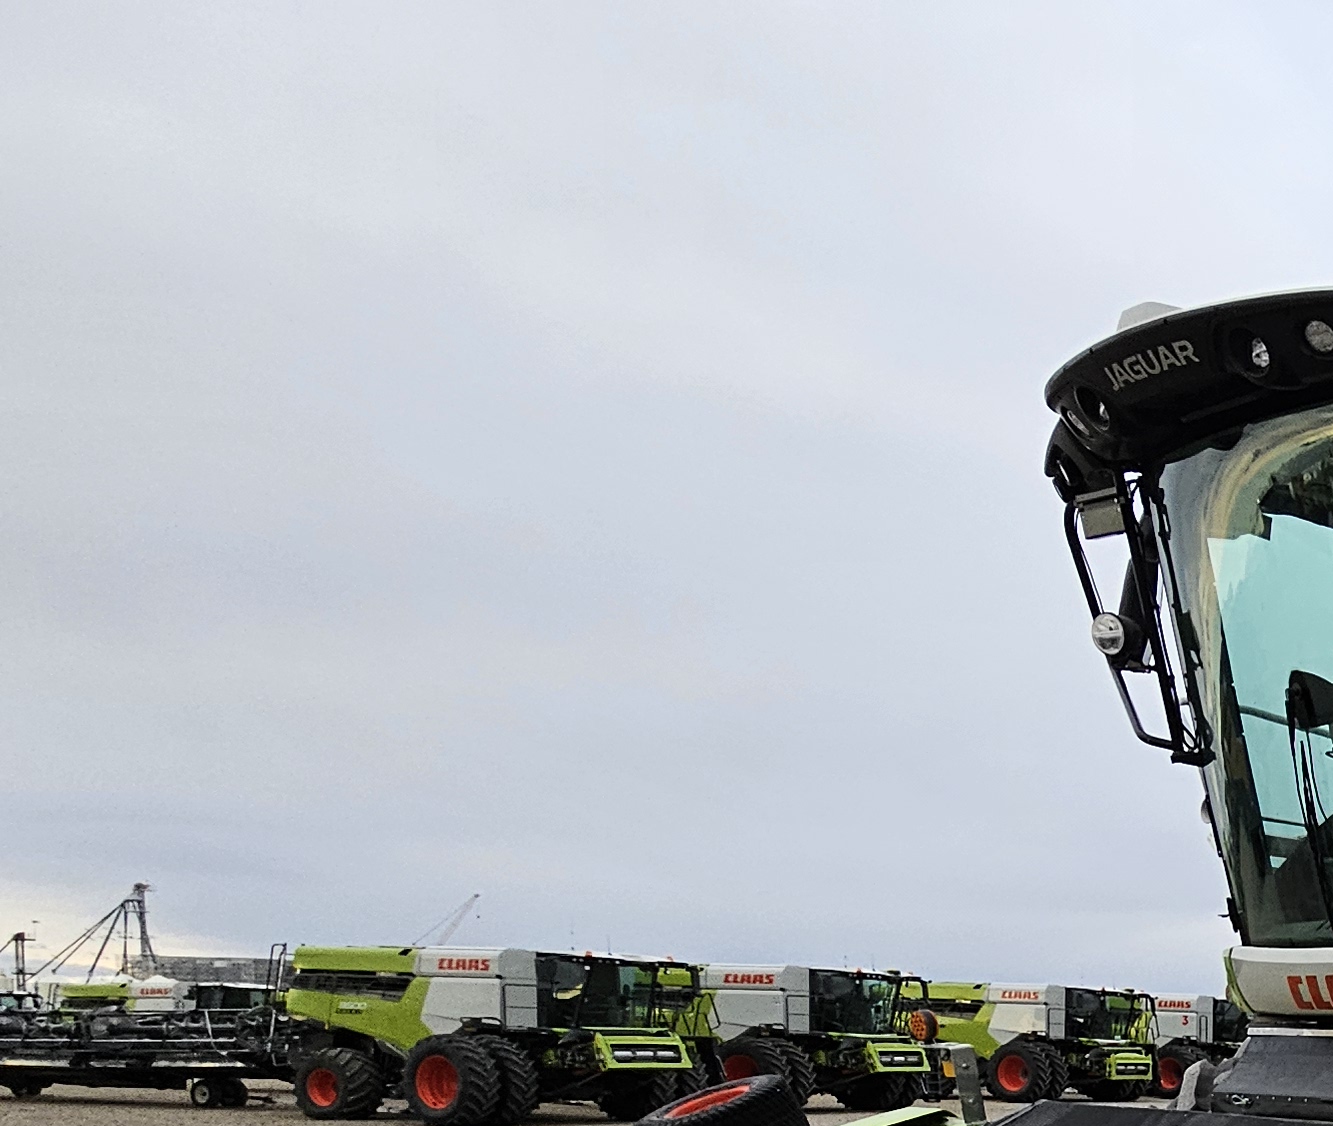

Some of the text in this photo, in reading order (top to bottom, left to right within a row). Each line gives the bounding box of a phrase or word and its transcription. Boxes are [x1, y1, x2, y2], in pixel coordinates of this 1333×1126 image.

[1103, 339, 1200, 392] JAGUAR
[437, 957, 491, 972] CLAAS
[723, 972, 776, 985] CLAAS
[1001, 990, 1040, 1000] CLAAS
[1158, 1000, 1192, 1009] CLAAS
[1181, 1014, 1189, 1026] 3
